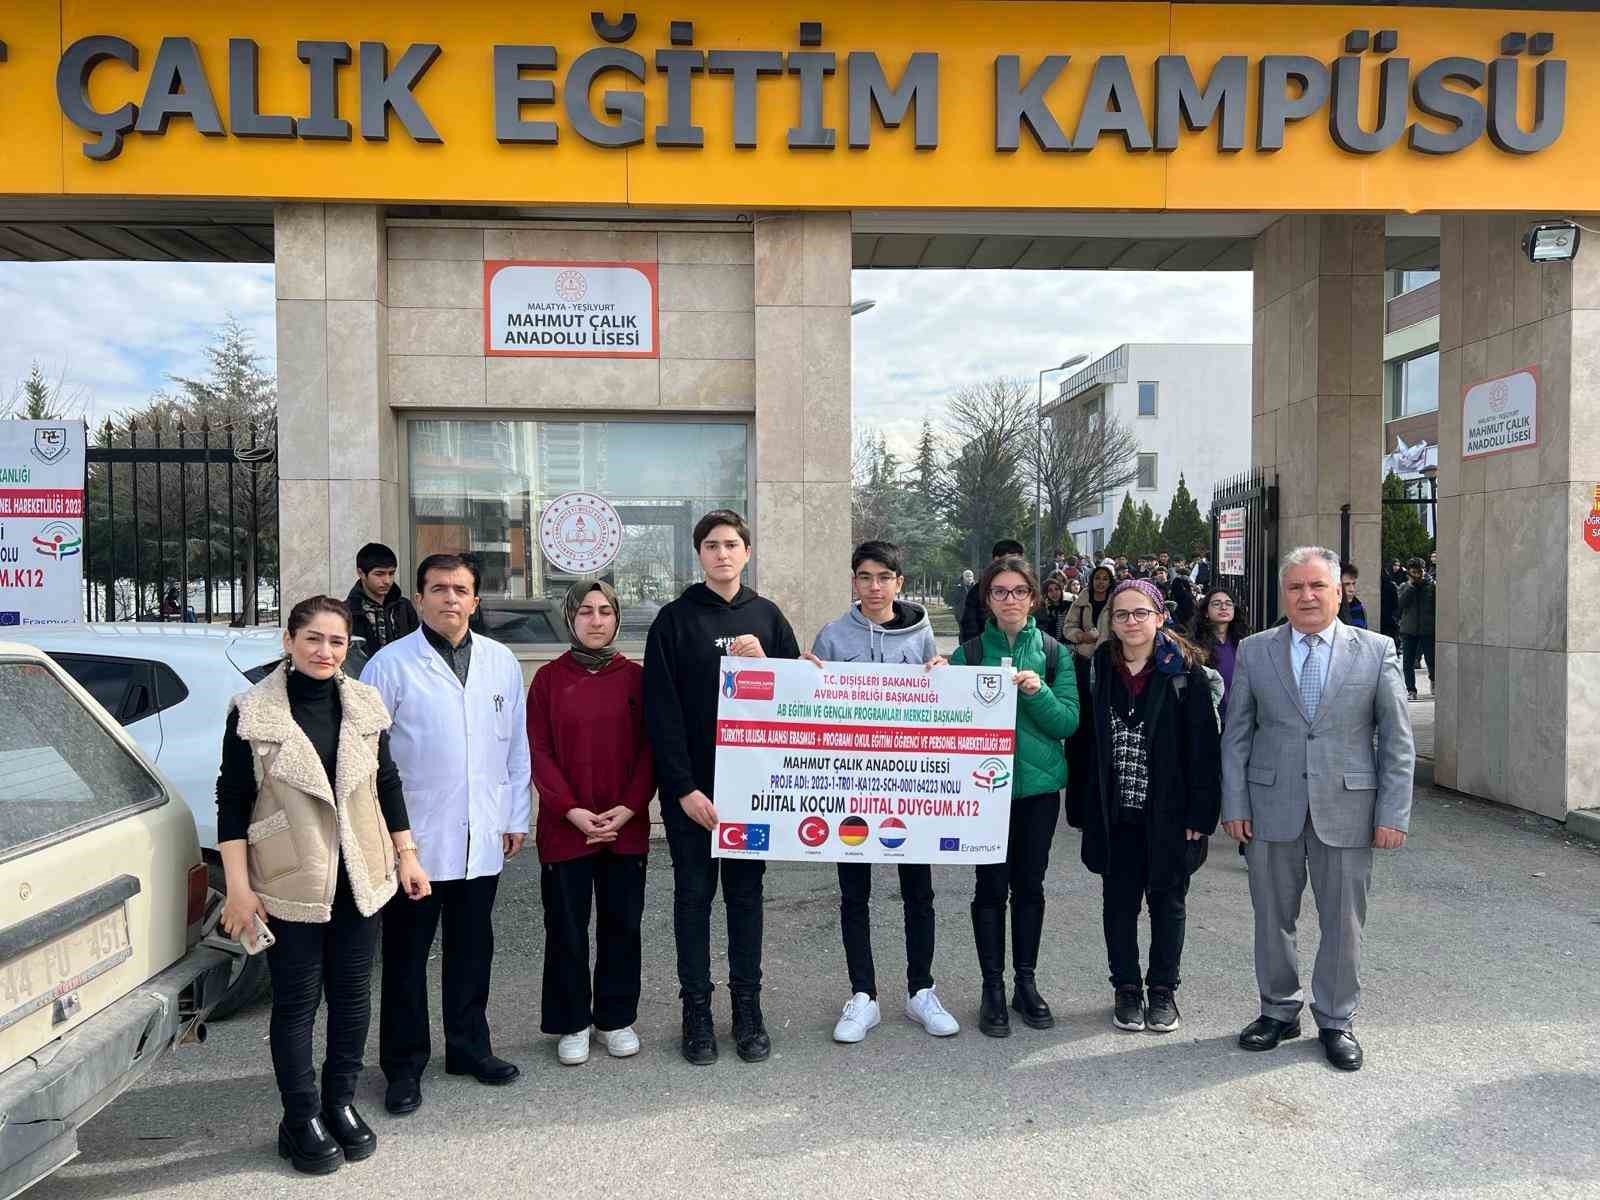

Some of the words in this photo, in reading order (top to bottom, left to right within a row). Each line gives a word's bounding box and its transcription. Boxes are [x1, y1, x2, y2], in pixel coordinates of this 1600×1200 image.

[56, 35, 444, 162] ÇALIK
[493, 12, 938, 150] EĞİTİM
[994, 30, 1567, 154] KAMPÜSÜ
[528, 303, 566, 311] MALATYA
[573, 303, 615, 313] YEŞİLYURT
[508, 313, 584, 328] MAHMUT
[589, 315, 637, 331] ÇALIK
[505, 331, 587, 345] ANADOLU
[592, 329, 640, 346] LİSESİ
[1469, 421, 1504, 439] MAHMUT
[1506, 415, 1530, 431] ÇALIK
[1467, 435, 1505, 452] ANADOLU
[14, 494, 63, 514] HAREKETLİLİĞİ
[65, 498, 81, 514] 2023
[1, 547, 18, 562] OLU
[823, 674, 837, 685] T.C.
[882, 675, 930, 688] BAKANLIĞI
[814, 689, 849, 700] AVRUPA
[885, 691, 938, 704] BAŞKANLIĞI
[777, 703, 787, 716] AB
[788, 700, 812, 717] EĞİTİM
[814, 705, 822, 717] VE
[823, 704, 852, 721] GENÇLİK
[854, 706, 901, 720] PROGRAMLARI
[903, 706, 932, 722] MERKEZİ
[934, 707, 973, 724] BAŞKANLIĞI
[721, 724, 744, 743] TÜRKİYE
[745, 728, 767, 744] ULUSAL
[767, 729, 788, 744] AJANSI
[789, 731, 816, 745] ERASMUS
[854, 733, 870, 748] OKUL
[921, 735, 928, 748] VE
[928, 736, 956, 750] PERSONEL
[783, 756, 831, 770] MAHMUT
[833, 758, 863, 773] ÇALIK
[865, 759, 917, 772] ANADOLU
[921, 757, 950, 773] LİSESİ
[770, 775, 793, 789] PROJE
[940, 780, 961, 794] NOLU
[751, 789, 796, 812] DİJİTAL
[800, 796, 846, 816] KOÇUM
[850, 792, 894, 814] DİJİTAL
[898, 798, 980, 816] DUYGUM.K12
